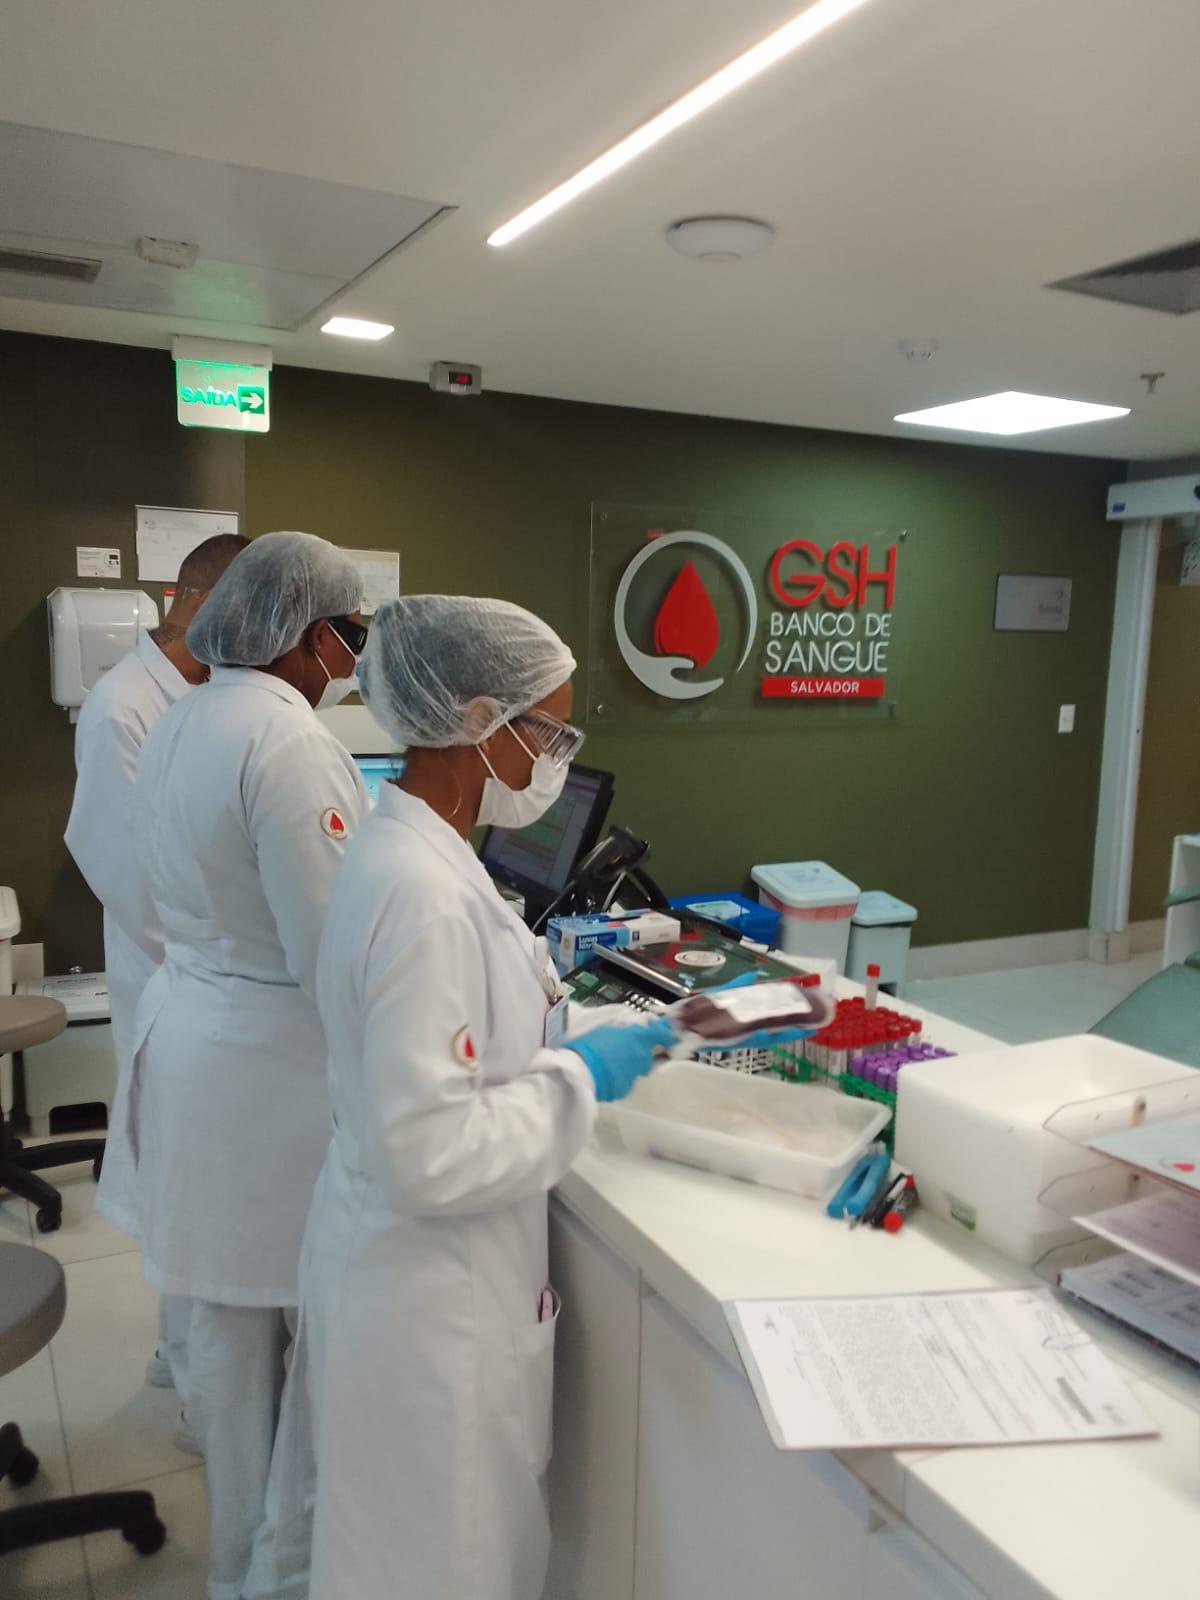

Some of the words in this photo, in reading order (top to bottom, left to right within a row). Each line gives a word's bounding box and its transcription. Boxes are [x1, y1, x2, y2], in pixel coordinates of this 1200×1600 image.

[181, 386, 237, 407] SAÍDA
[770, 539, 896, 608] GSH
[770, 612, 855, 636] BANCO
[865, 613, 892, 636] DE
[765, 640, 889, 673] SANGUE
[790, 681, 860, 694] SALVADOR
